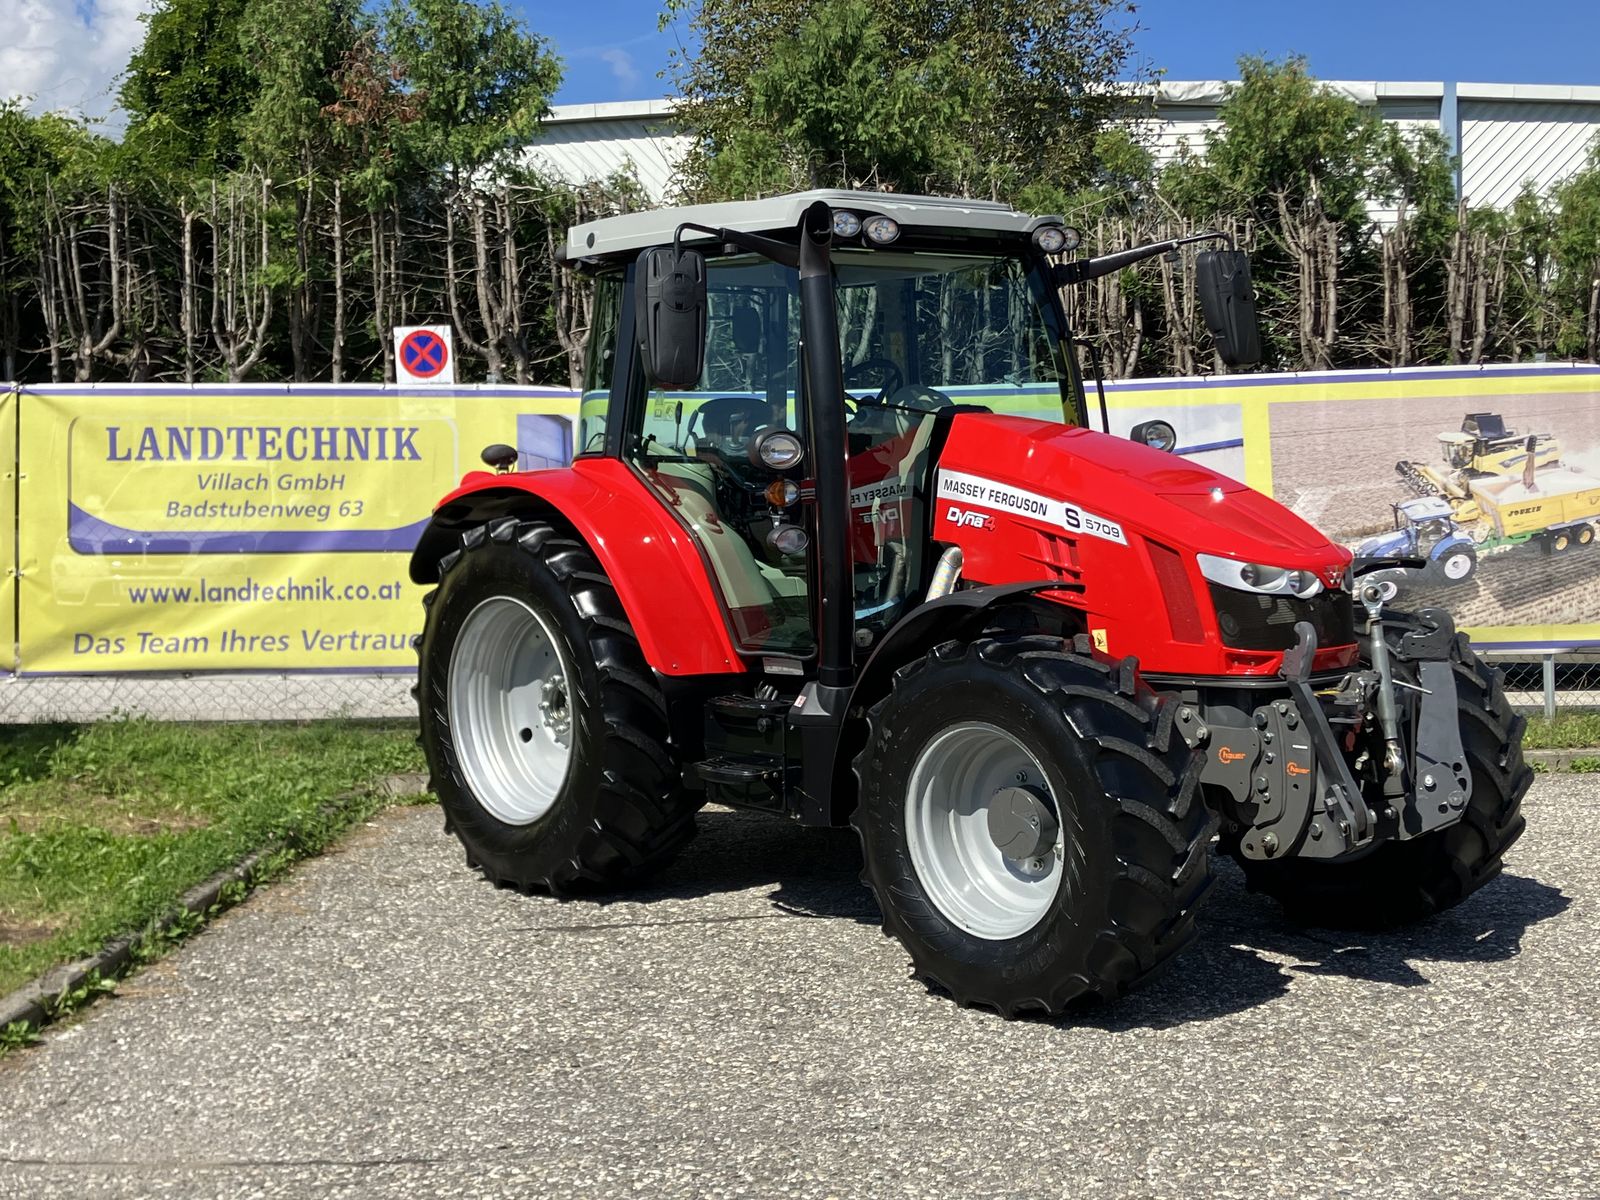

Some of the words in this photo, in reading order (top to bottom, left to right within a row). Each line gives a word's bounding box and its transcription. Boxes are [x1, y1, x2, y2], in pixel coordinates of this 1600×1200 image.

[106, 426, 422, 462] LANDTECHNIK
[197, 473, 270, 491] Villach
[277, 473, 346, 491] GmbH
[166, 500, 331, 522] Badstubenweg
[338, 499, 364, 516] 63
[943, 479, 986, 499] MASSEY
[988, 489, 1048, 517] FERGUSON
[1064, 507, 1081, 529] S
[1085, 518, 1120, 539] 5709
[128, 576, 402, 604] www.landtechnik.co.at
[73, 632, 126, 655] Das
[137, 631, 210, 654] Team
[220, 629, 290, 653] Ihres
